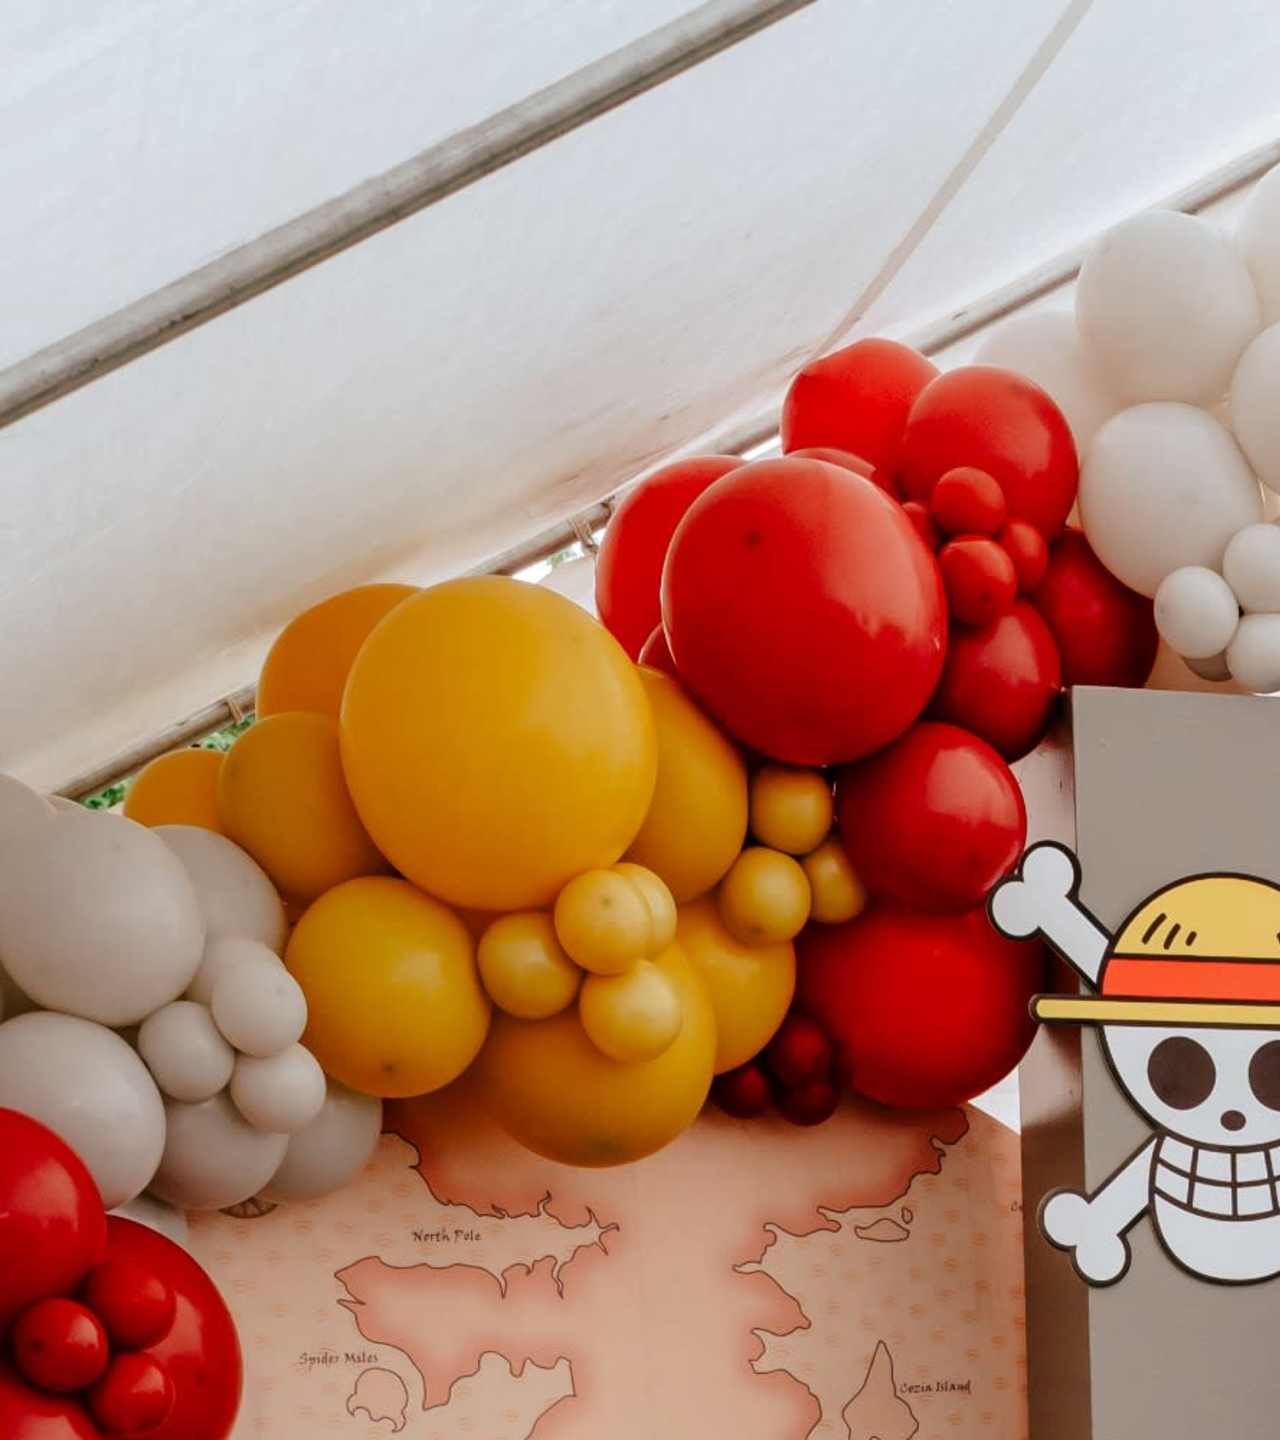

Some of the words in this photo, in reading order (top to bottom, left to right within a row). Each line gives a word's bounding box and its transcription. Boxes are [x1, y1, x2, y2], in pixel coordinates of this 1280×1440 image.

[412, 1227, 450, 1243] North
[453, 1229, 481, 1242] Pole
[299, 1352, 339, 1371] Spider
[344, 1351, 379, 1364] Miles
[936, 1379, 972, 1395] Island
